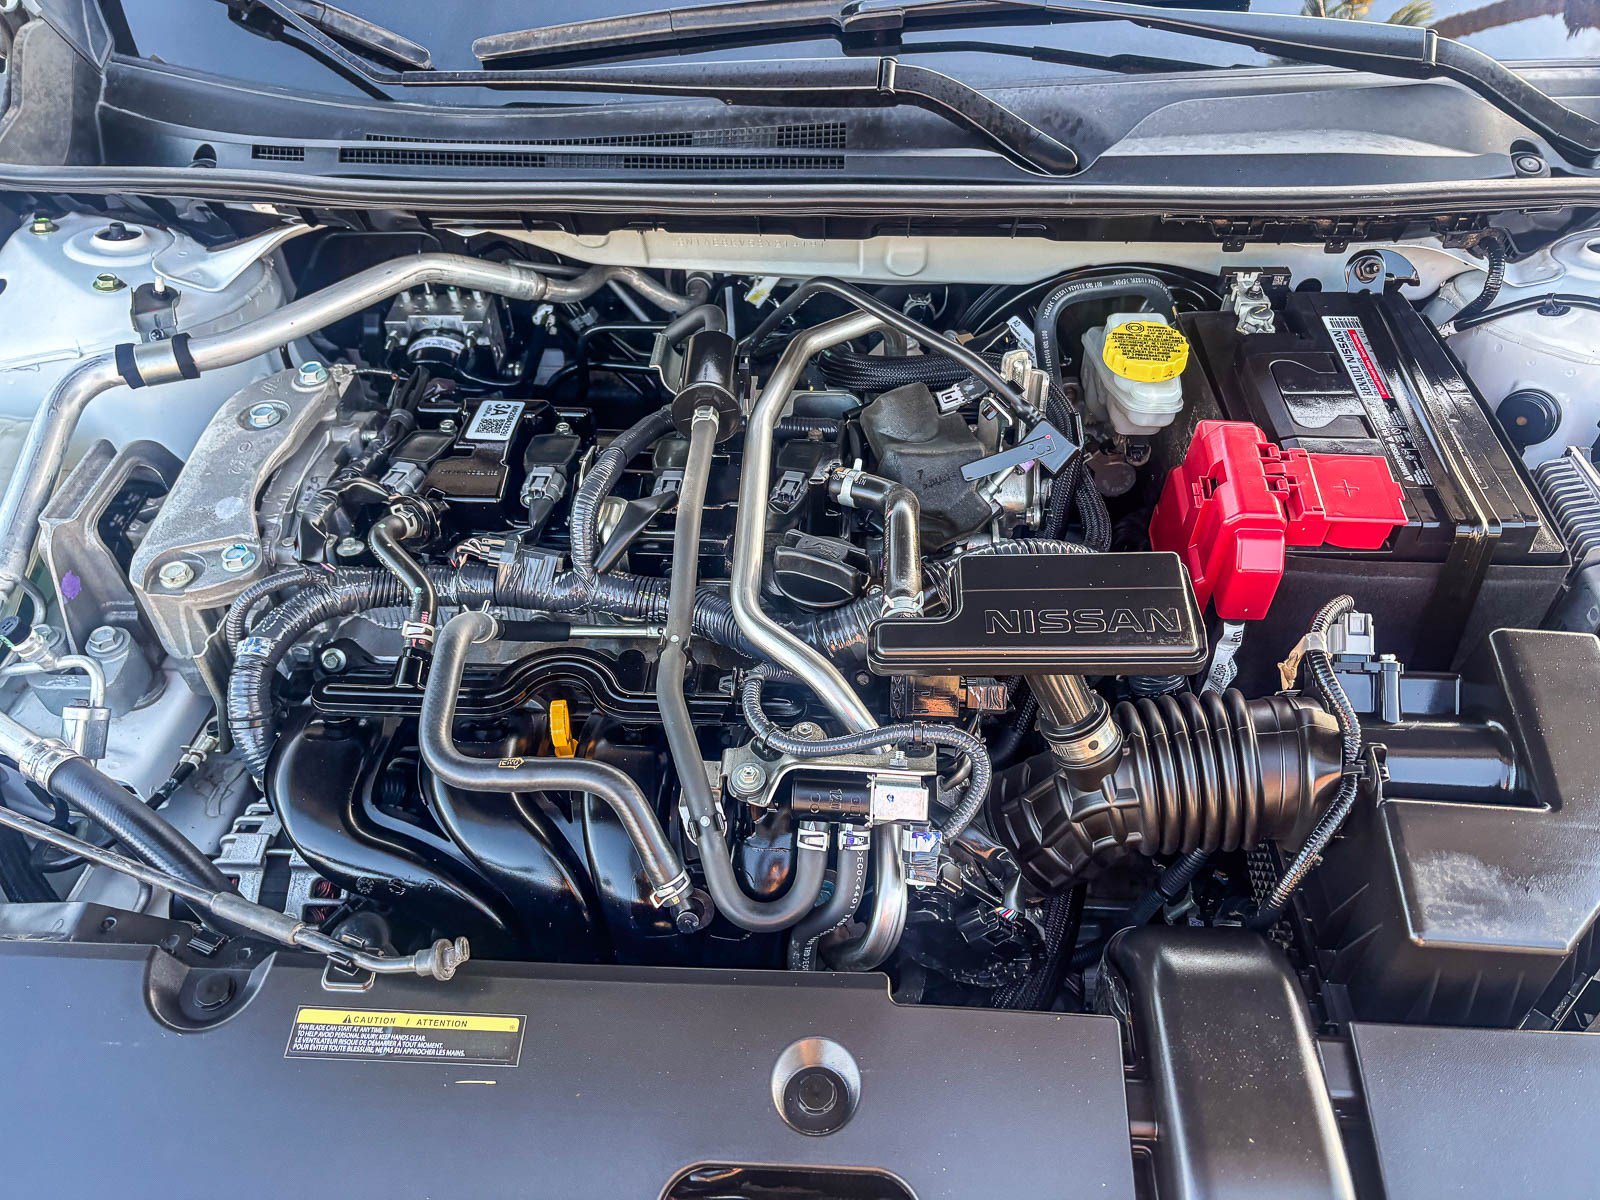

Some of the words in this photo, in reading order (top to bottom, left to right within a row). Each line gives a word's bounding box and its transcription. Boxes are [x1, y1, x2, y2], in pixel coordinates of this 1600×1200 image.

[1332, 330, 1356, 363] NISSAN
[1349, 364, 1373, 397] RENAULT
[490, 403, 511, 416] 3A
[984, 598, 1182, 634] NISSAN
[353, 1016, 396, 1025] CAUTION
[416, 1019, 468, 1027] ATTENTION
[302, 1037, 338, 1045] VENTILATEUR
[403, 1048, 435, 1056] APPROCHER
